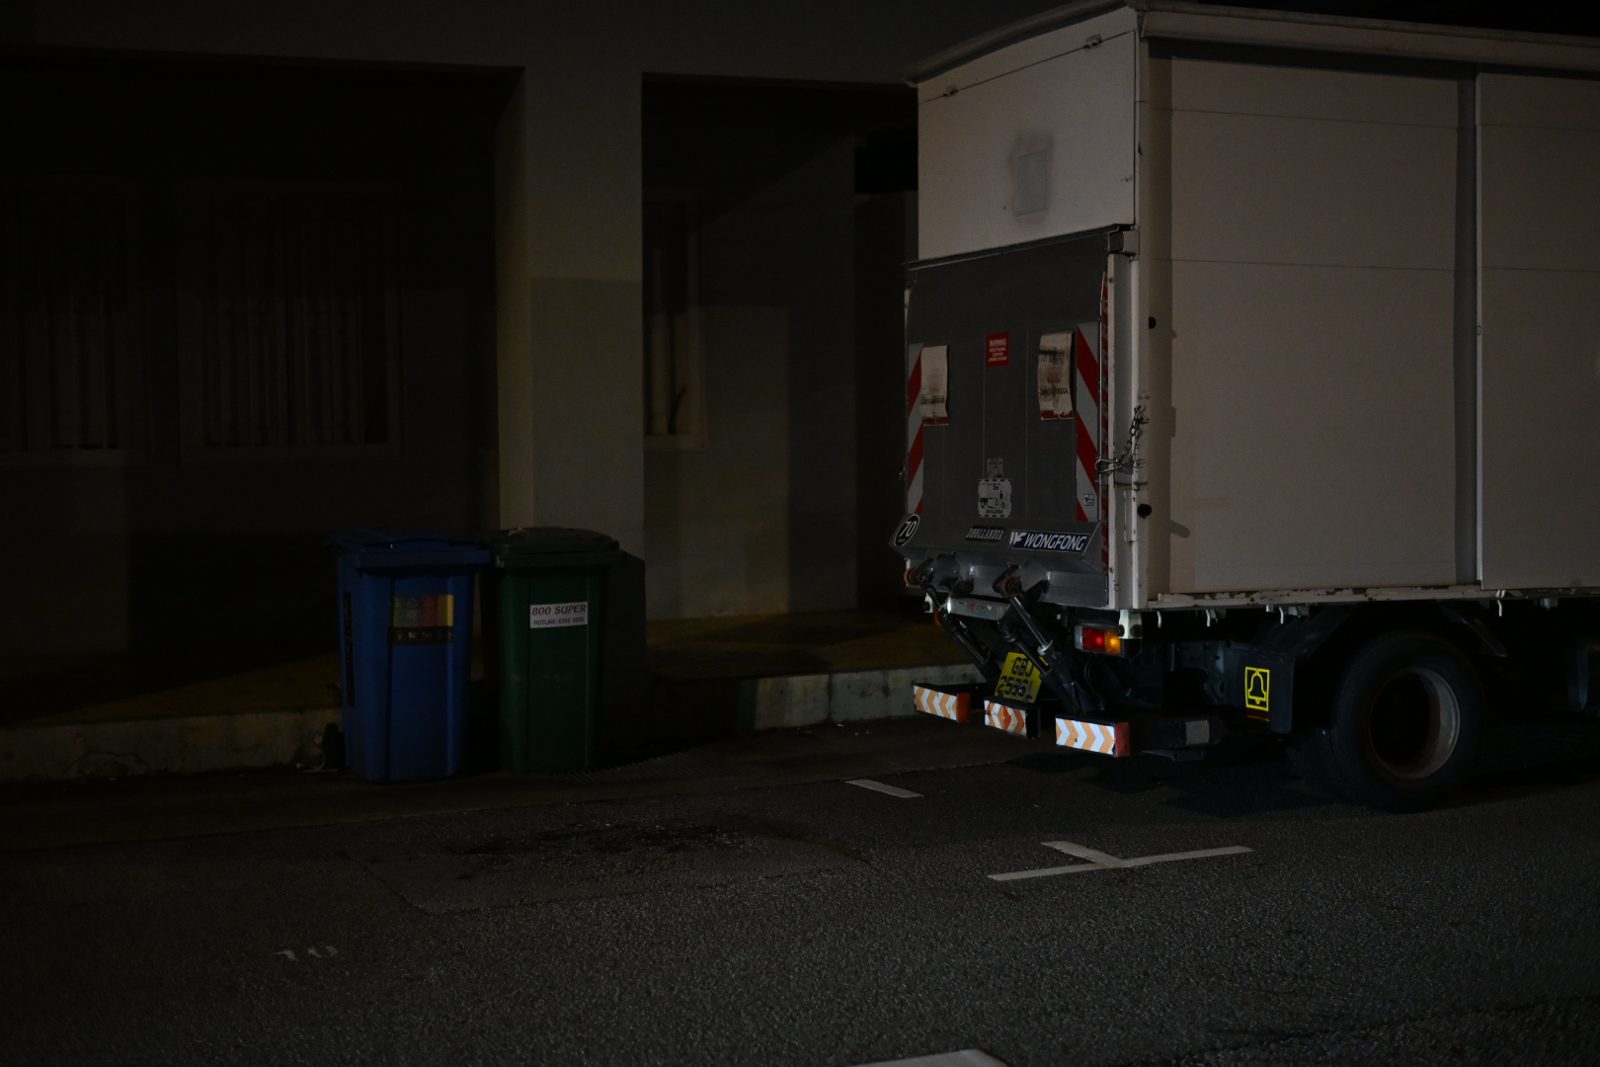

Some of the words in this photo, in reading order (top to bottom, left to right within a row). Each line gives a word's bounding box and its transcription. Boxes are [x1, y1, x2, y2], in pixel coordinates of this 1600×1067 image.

[899, 520, 917, 537] 70
[1024, 533, 1087, 551] WONGFONG
[532, 606, 551, 616] 800
[554, 604, 586, 615] SUPER
[1012, 656, 1034, 677] GBJ
